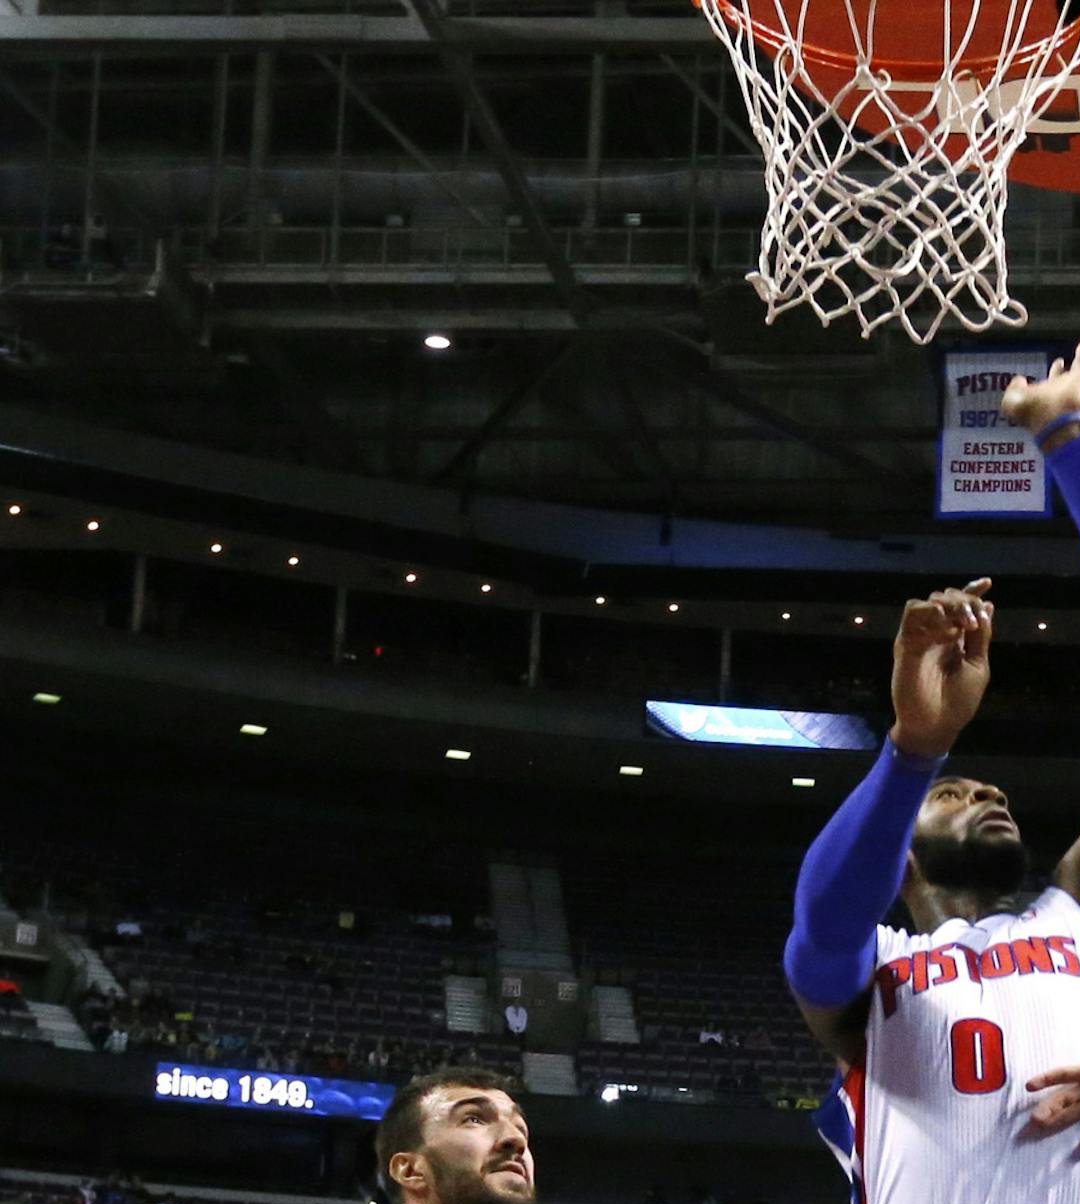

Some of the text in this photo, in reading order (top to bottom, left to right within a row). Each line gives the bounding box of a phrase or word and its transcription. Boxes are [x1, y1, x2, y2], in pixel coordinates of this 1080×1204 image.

[956, 372, 1037, 396] PISTO
[964, 442, 1024, 455] EASTERN
[951, 460, 1036, 474] CONFERENCE
[954, 480, 1032, 492] CHAMPIONS
[950, 1017, 1008, 1095] 0
[156, 1067, 314, 1109] since 1849.
